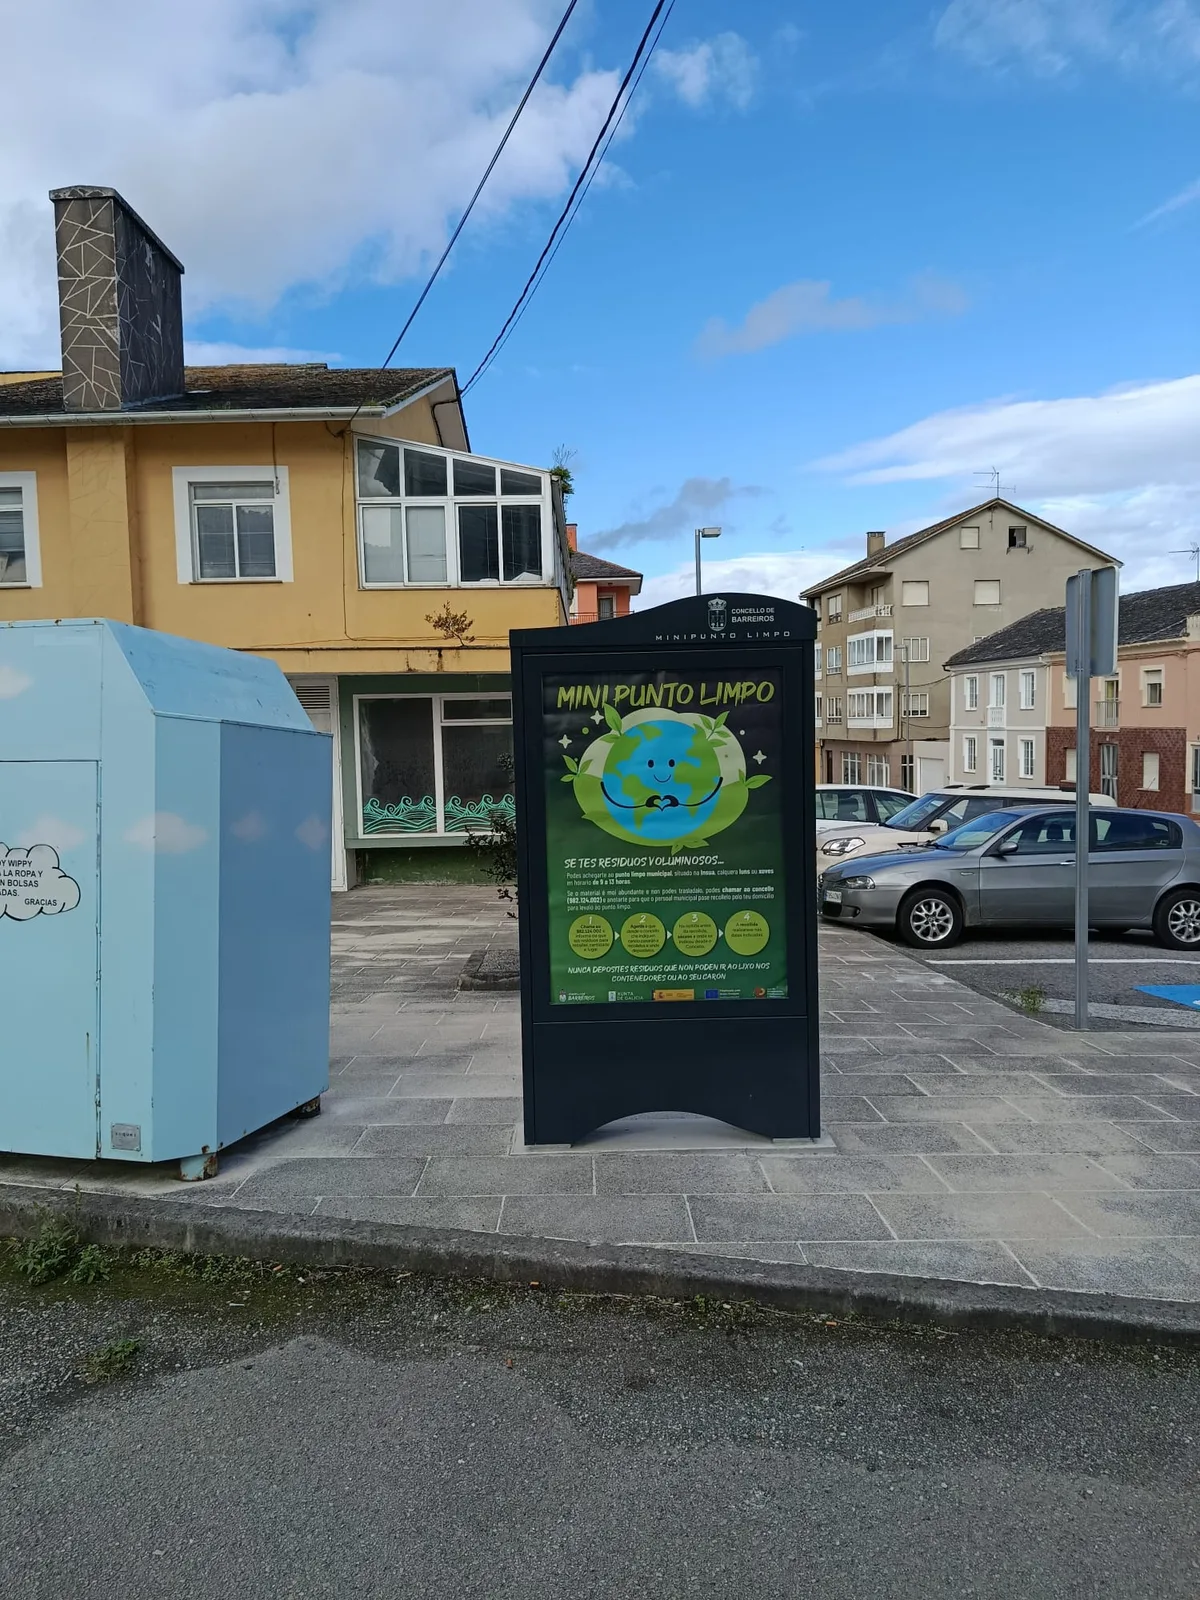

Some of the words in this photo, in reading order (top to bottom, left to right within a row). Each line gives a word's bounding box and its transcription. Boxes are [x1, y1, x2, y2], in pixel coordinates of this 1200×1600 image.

[656, 632, 736, 640] MINIPUNTO
[557, 684, 608, 711] MINI
[613, 682, 694, 708] PUNTO
[700, 681, 775, 707] LIMPO
[564, 858, 576, 868] SE
[578, 858, 596, 868] TES
[598, 857, 646, 868] RESIDUOS
[8, 880, 38, 888] BOLSAS
[24, 898, 57, 906] GRACIAS
[588, 916, 592, 924] 1
[640, 914, 646, 924] 2
[692, 914, 698, 922] 3
[744, 912, 750, 921] 4
[592, 966, 629, 974] DEPOSITES
[630, 964, 663, 973] RESIDUOS
[664, 964, 678, 972] QUE
[678, 964, 694, 972] NON
